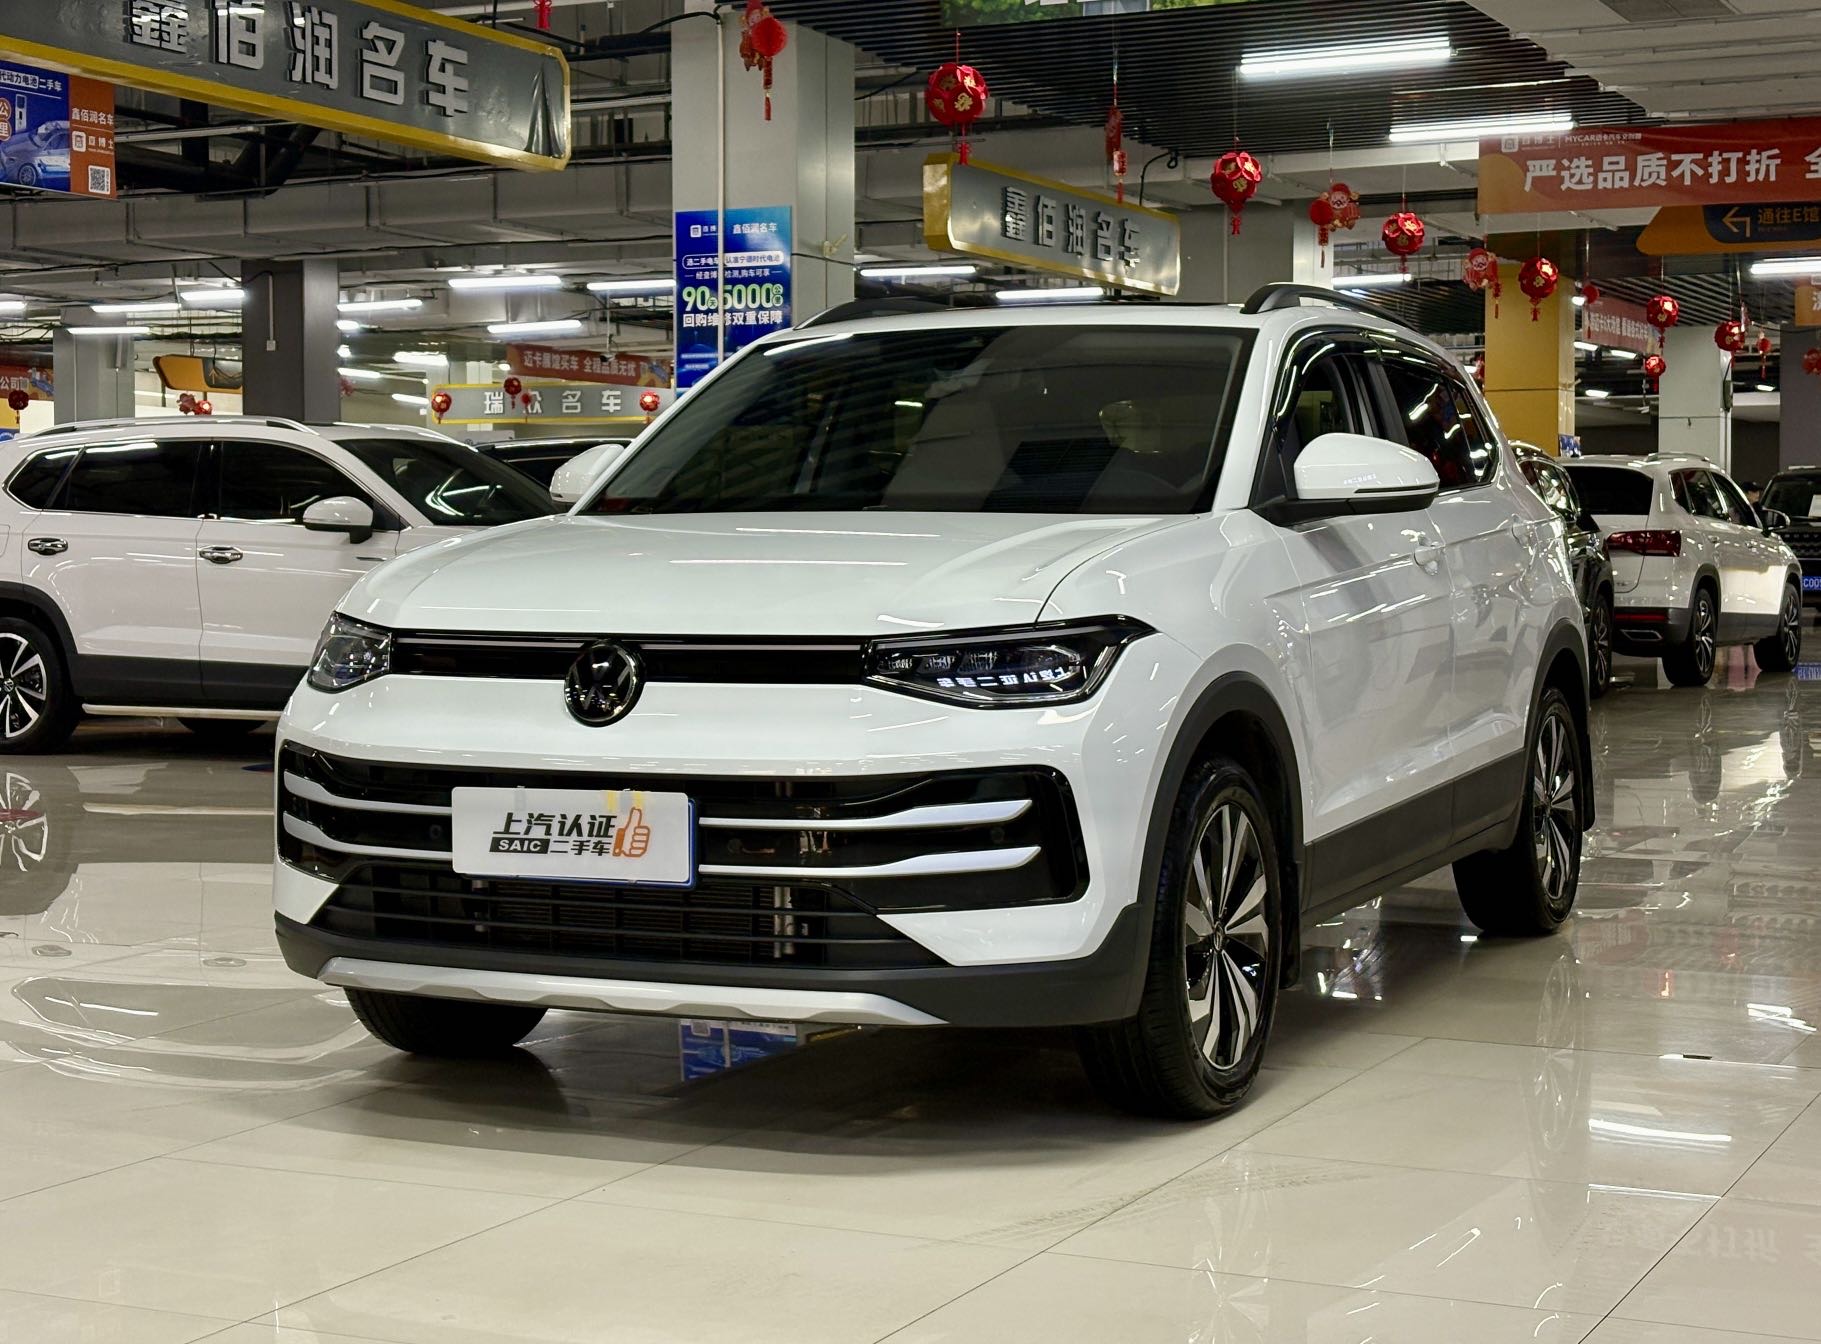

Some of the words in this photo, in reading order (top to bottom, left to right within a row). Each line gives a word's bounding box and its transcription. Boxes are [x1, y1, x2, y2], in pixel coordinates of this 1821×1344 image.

[72, 107, 114, 126] 鑫佰润名车
[1524, 149, 1781, 193] 严选品质不打折
[1004, 186, 1140, 268] 鑫佰润名车
[492, 812, 618, 840] 上汽认证
[498, 839, 543, 852] SAIC
[549, 839, 613, 857] 二手车
